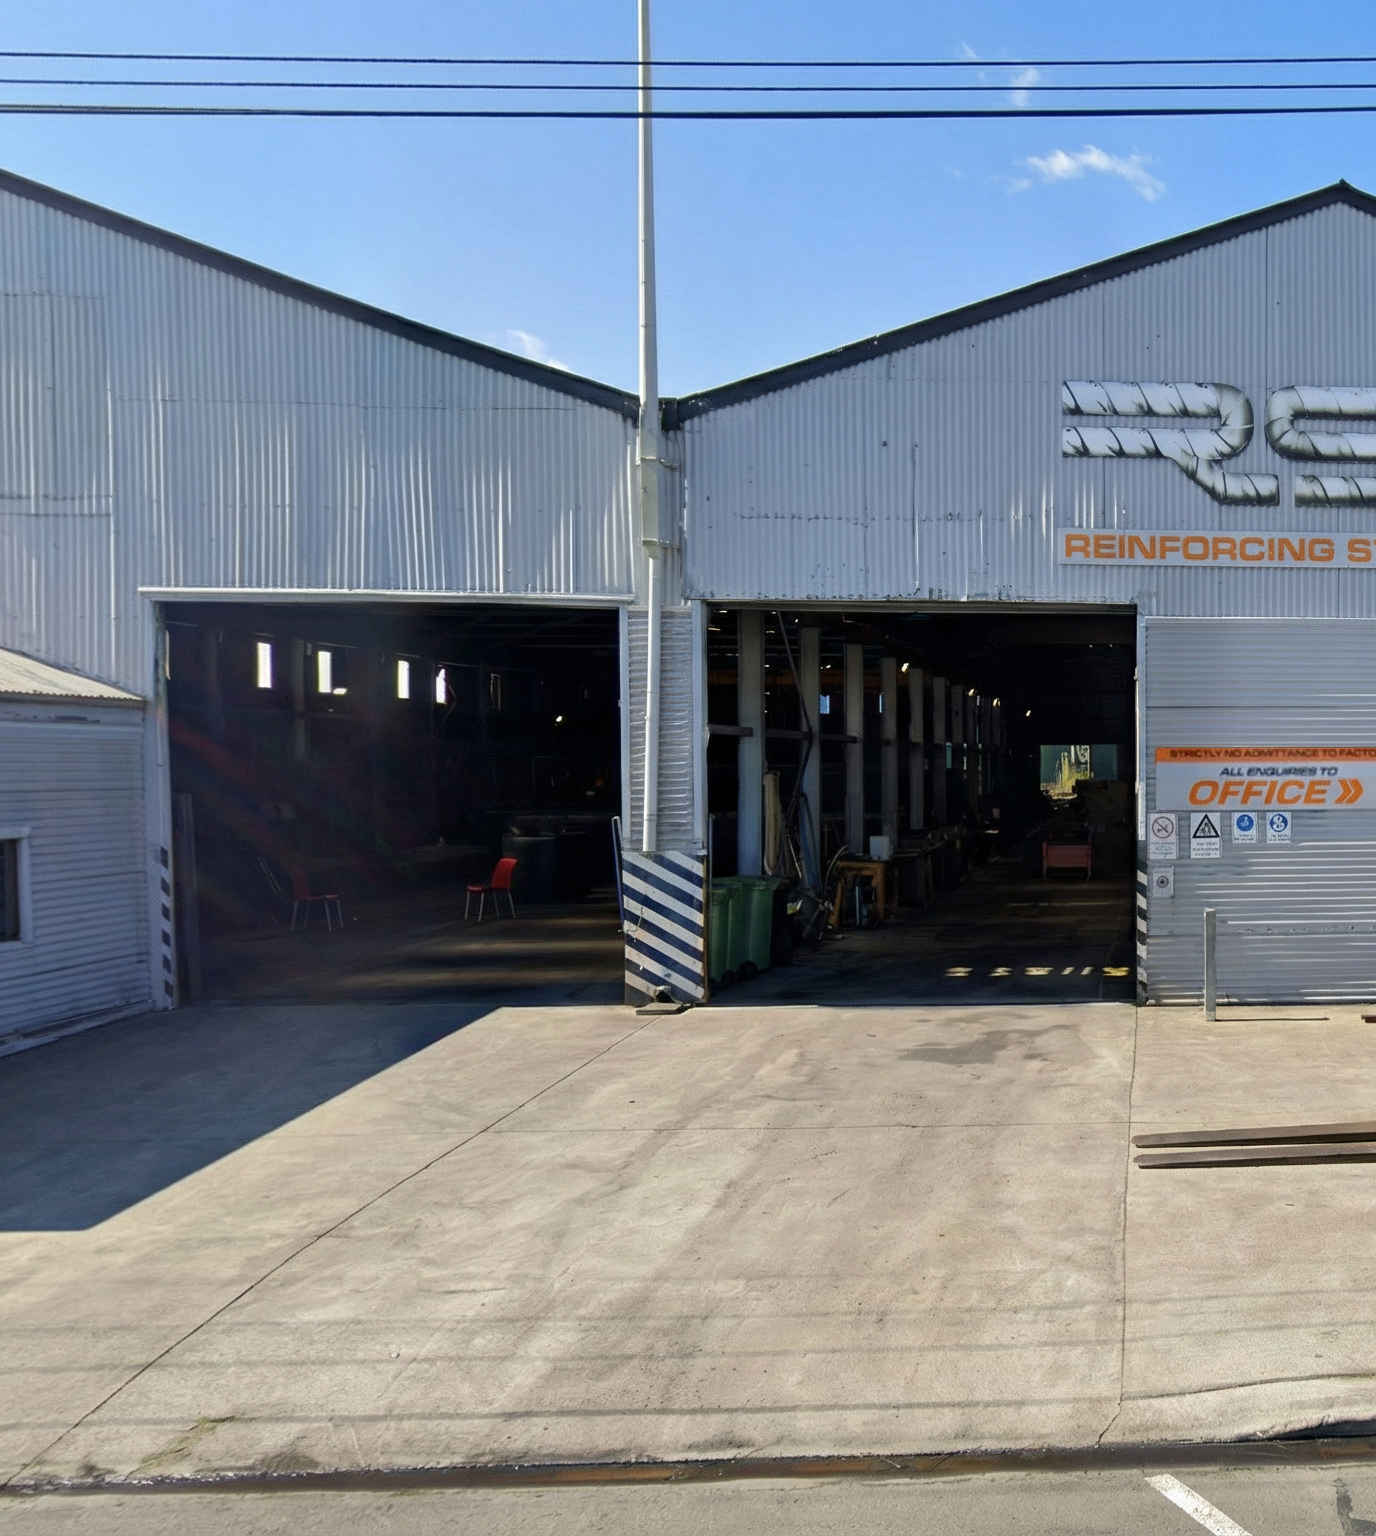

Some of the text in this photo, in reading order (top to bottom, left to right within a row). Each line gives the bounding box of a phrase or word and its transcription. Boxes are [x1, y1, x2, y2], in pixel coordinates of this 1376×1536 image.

[1064, 533, 1336, 563] REINFORCING
[1170, 748, 1221, 758] STRICTLY
[1225, 748, 1242, 758] NO
[1244, 748, 1319, 758] ADMITTANCE
[1322, 748, 1337, 758] TO
[1219, 767, 1243, 777] ALL
[1320, 767, 1338, 776] TO
[1188, 780, 1331, 806] OFFICE
